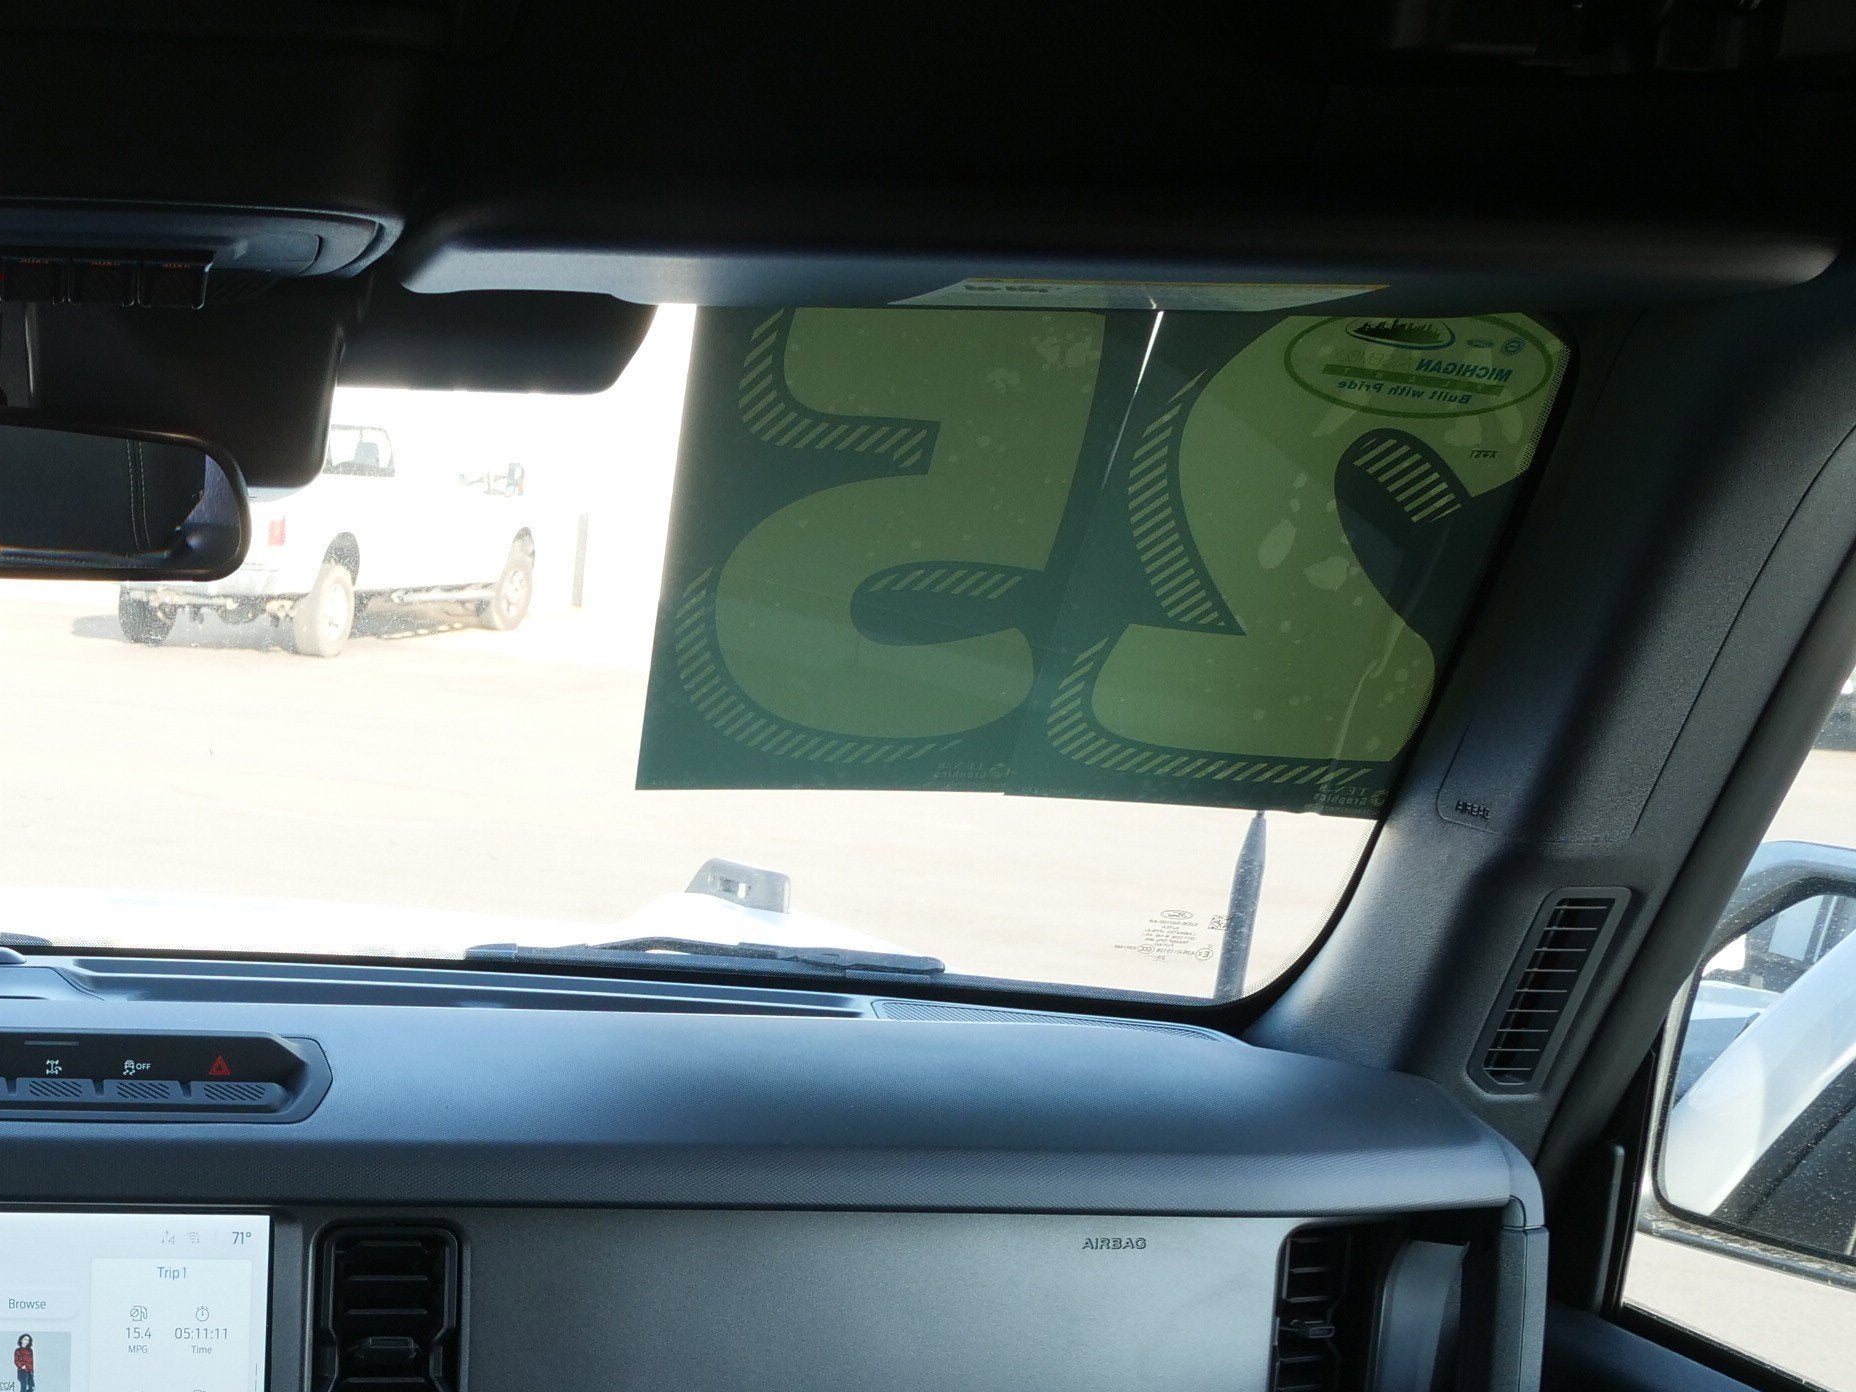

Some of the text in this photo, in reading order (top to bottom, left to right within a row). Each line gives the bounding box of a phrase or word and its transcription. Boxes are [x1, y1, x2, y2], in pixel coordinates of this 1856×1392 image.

[136, 1062, 151, 1071] OFF
[231, 1231, 252, 1245] 71°
[1081, 1236, 1148, 1250] AIRBAG
[157, 1267, 187, 1281] Trip 1
[8, 1299, 46, 1310] Browse
[125, 1327, 152, 1340] 15.4
[174, 1327, 229, 1340] 05:11:11
[127, 1345, 148, 1354] MPG
[191, 1345, 213, 1354] Time
